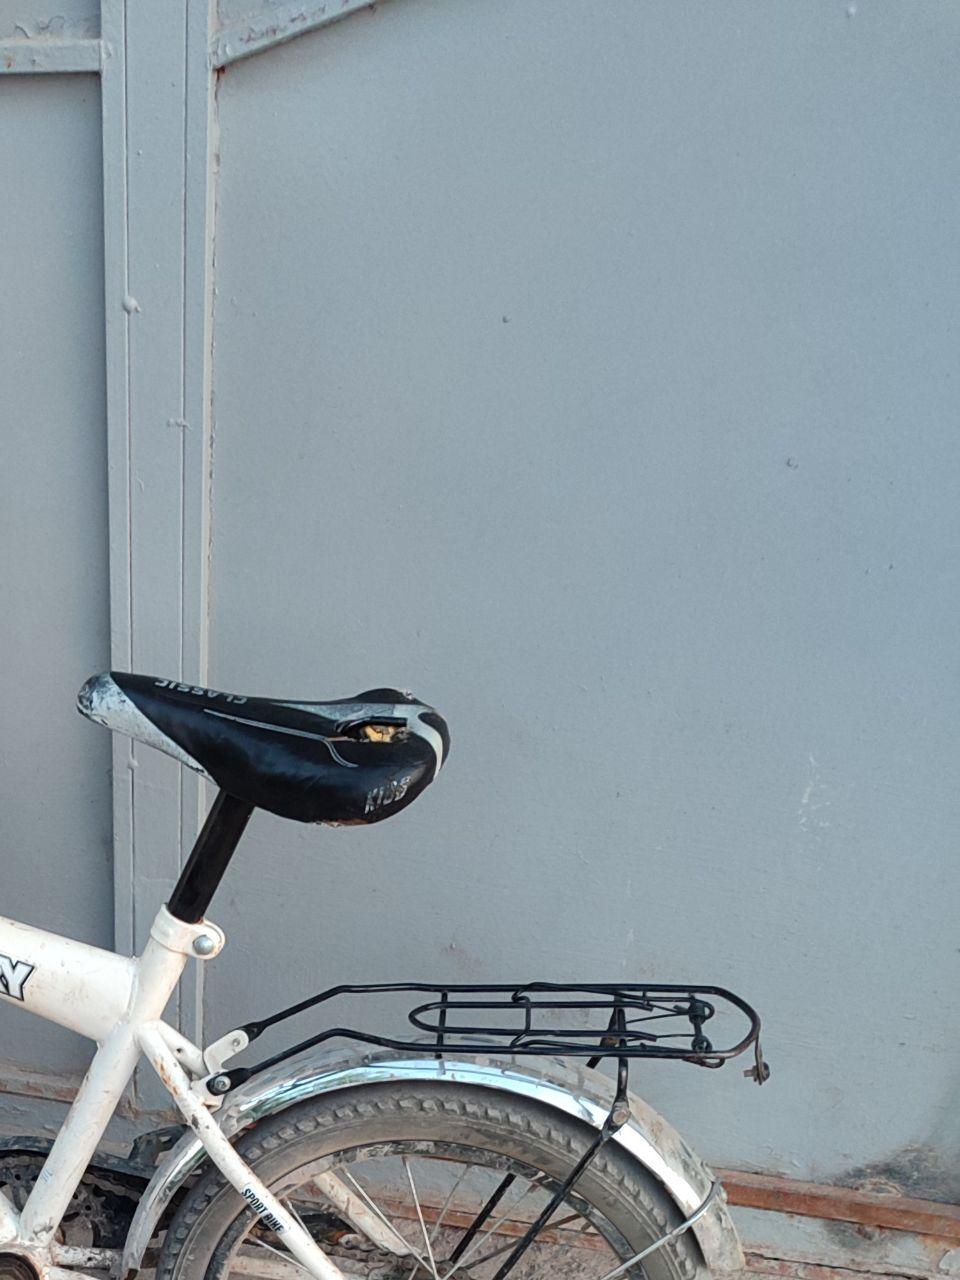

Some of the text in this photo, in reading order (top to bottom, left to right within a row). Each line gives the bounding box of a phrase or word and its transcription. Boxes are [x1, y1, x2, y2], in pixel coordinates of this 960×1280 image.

[154, 678, 248, 704] CLASSIC
[241, 1188, 285, 1233] SPORT BIKE
